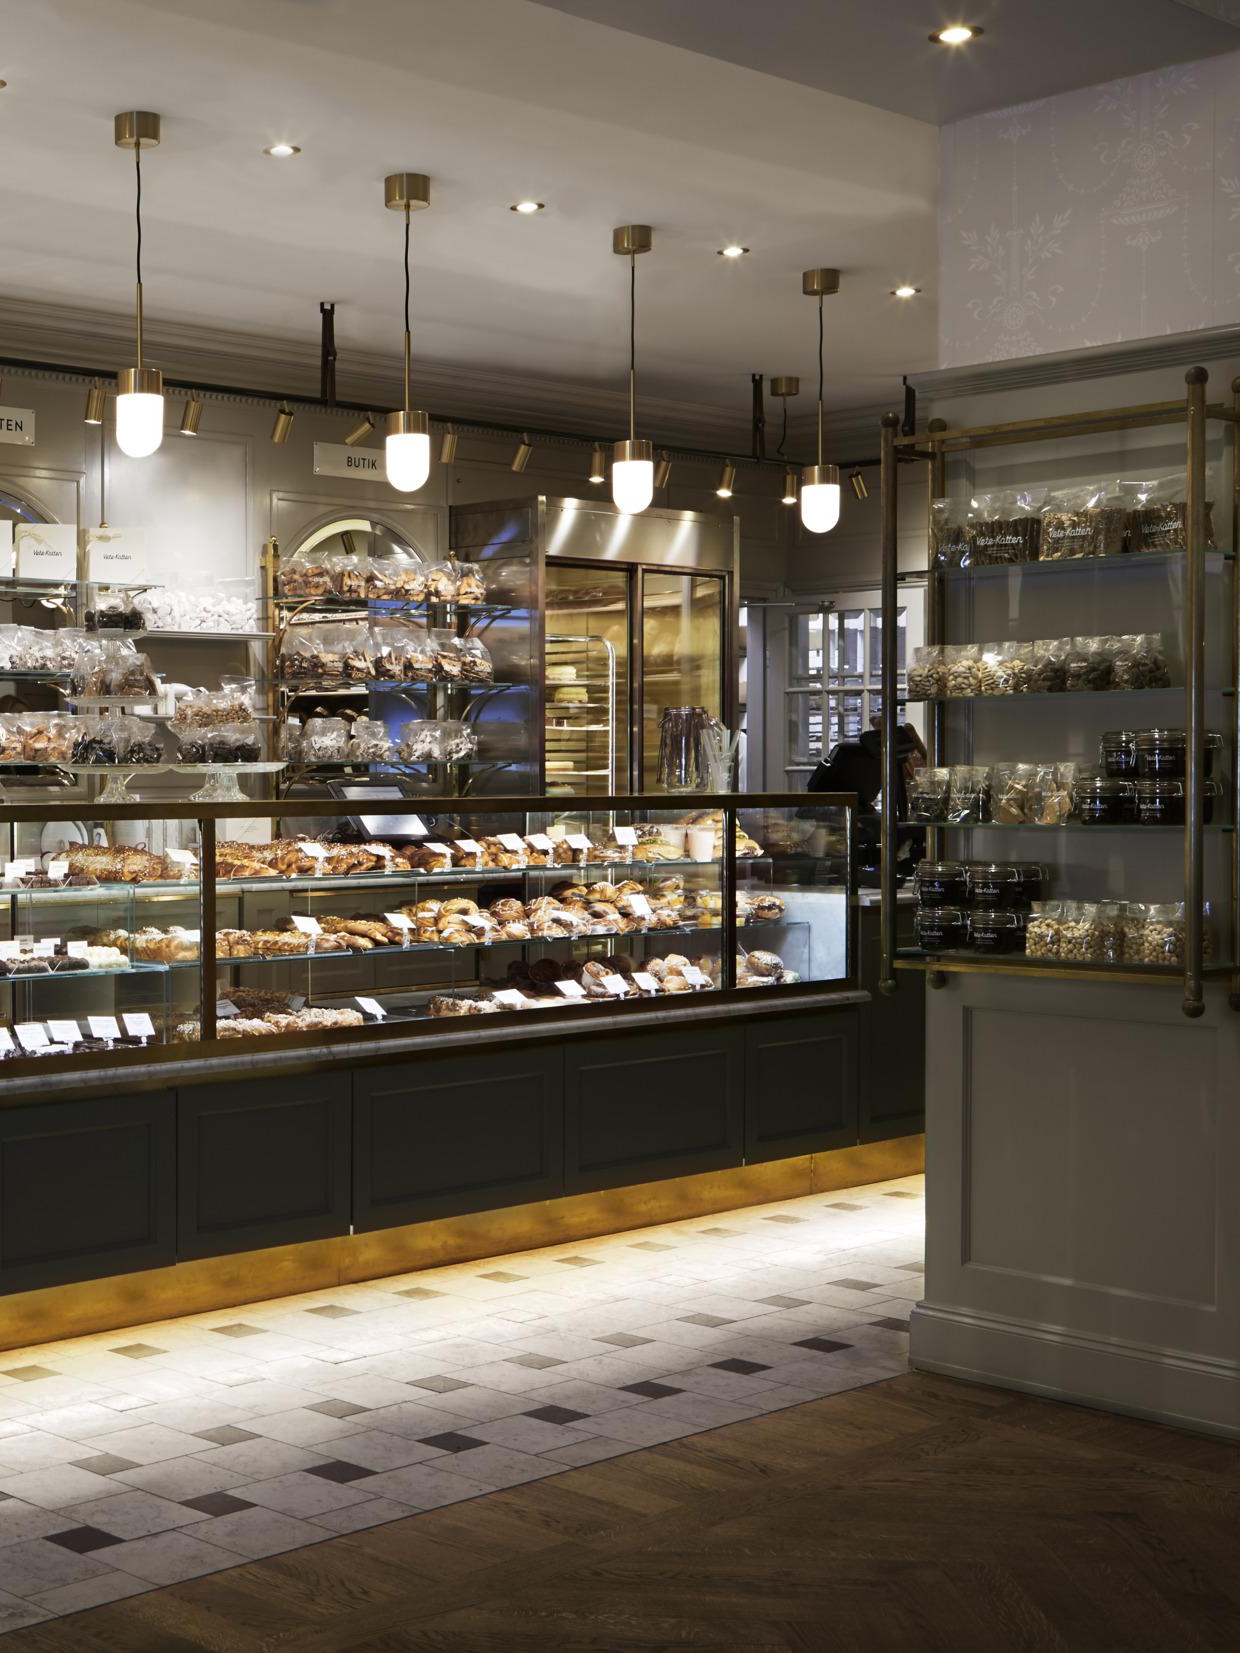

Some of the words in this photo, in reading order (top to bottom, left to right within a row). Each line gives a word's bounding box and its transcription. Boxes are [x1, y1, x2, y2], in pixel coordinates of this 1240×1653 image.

[346, 456, 377, 469] BUTIK
[1049, 527, 1093, 538] Vete-Katten
[976, 535, 1023, 545] Vete-Katten
